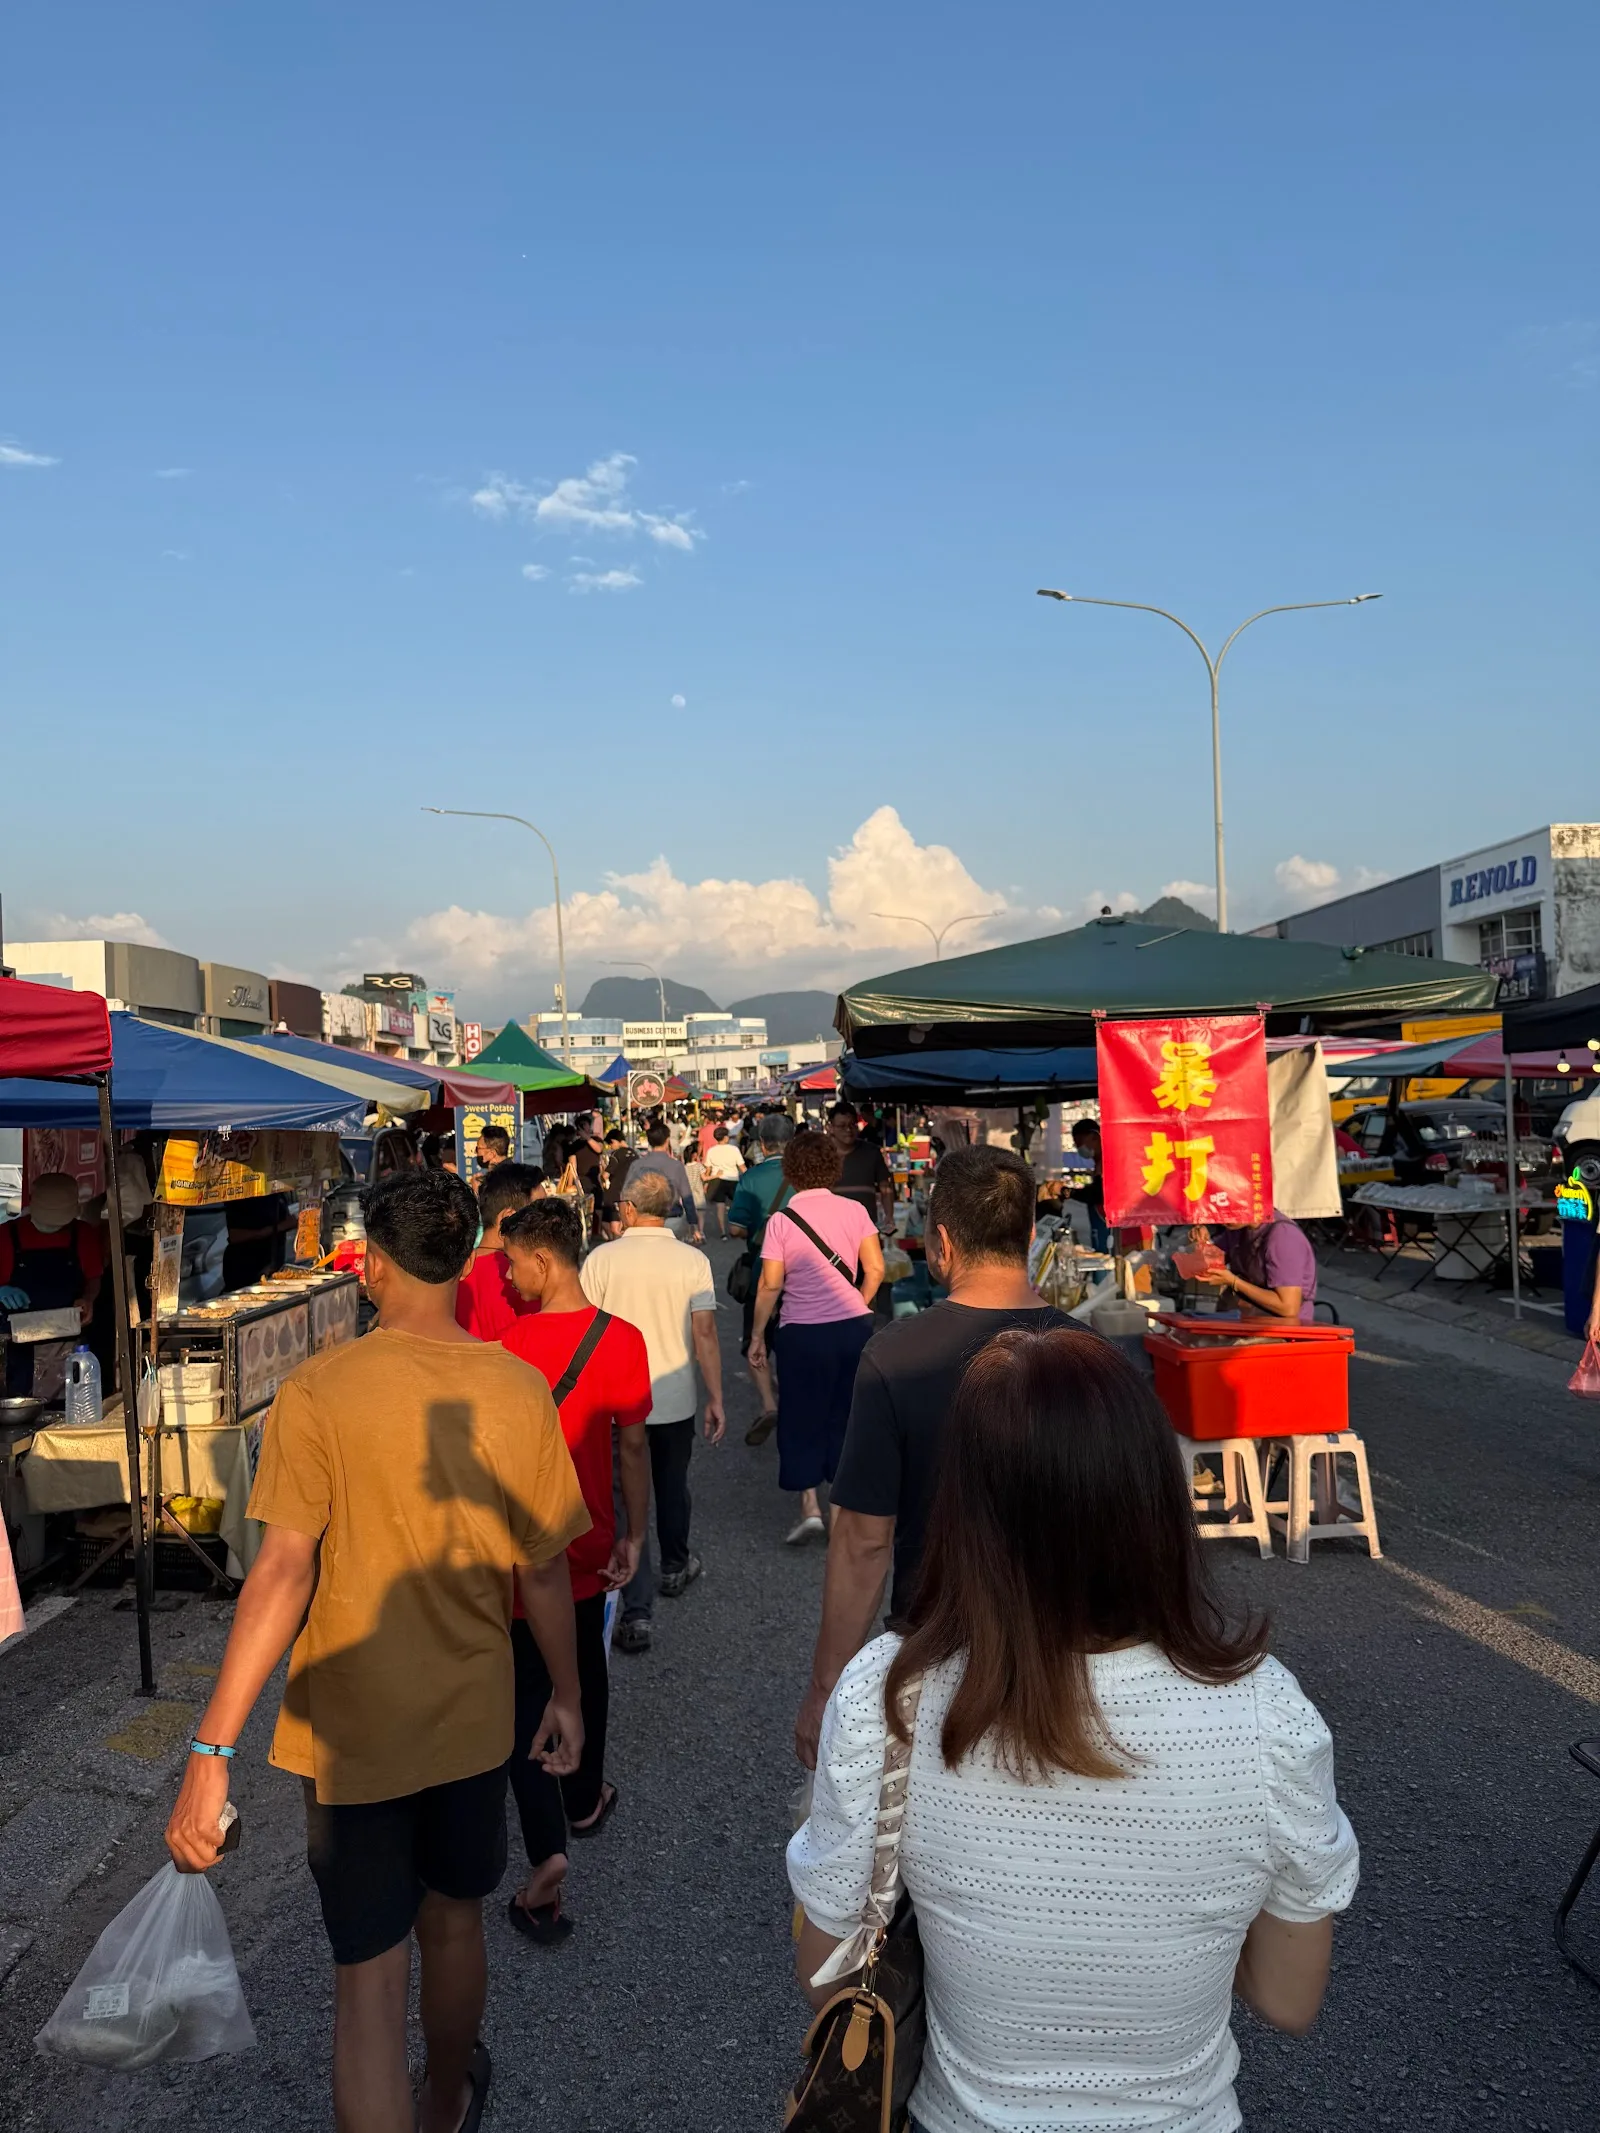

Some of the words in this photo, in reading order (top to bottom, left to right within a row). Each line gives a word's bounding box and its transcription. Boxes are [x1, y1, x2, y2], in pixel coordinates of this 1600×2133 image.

[1449, 856, 1537, 907] RENOLD
[365, 976, 412, 989] RG
[432, 1018, 453, 1041] RG
[625, 1027, 653, 1035] BUSINESS
[464, 1104, 488, 1112] Sweet
[489, 1103, 515, 1112] Potato
[1141, 1041, 1217, 1201] 暴打
